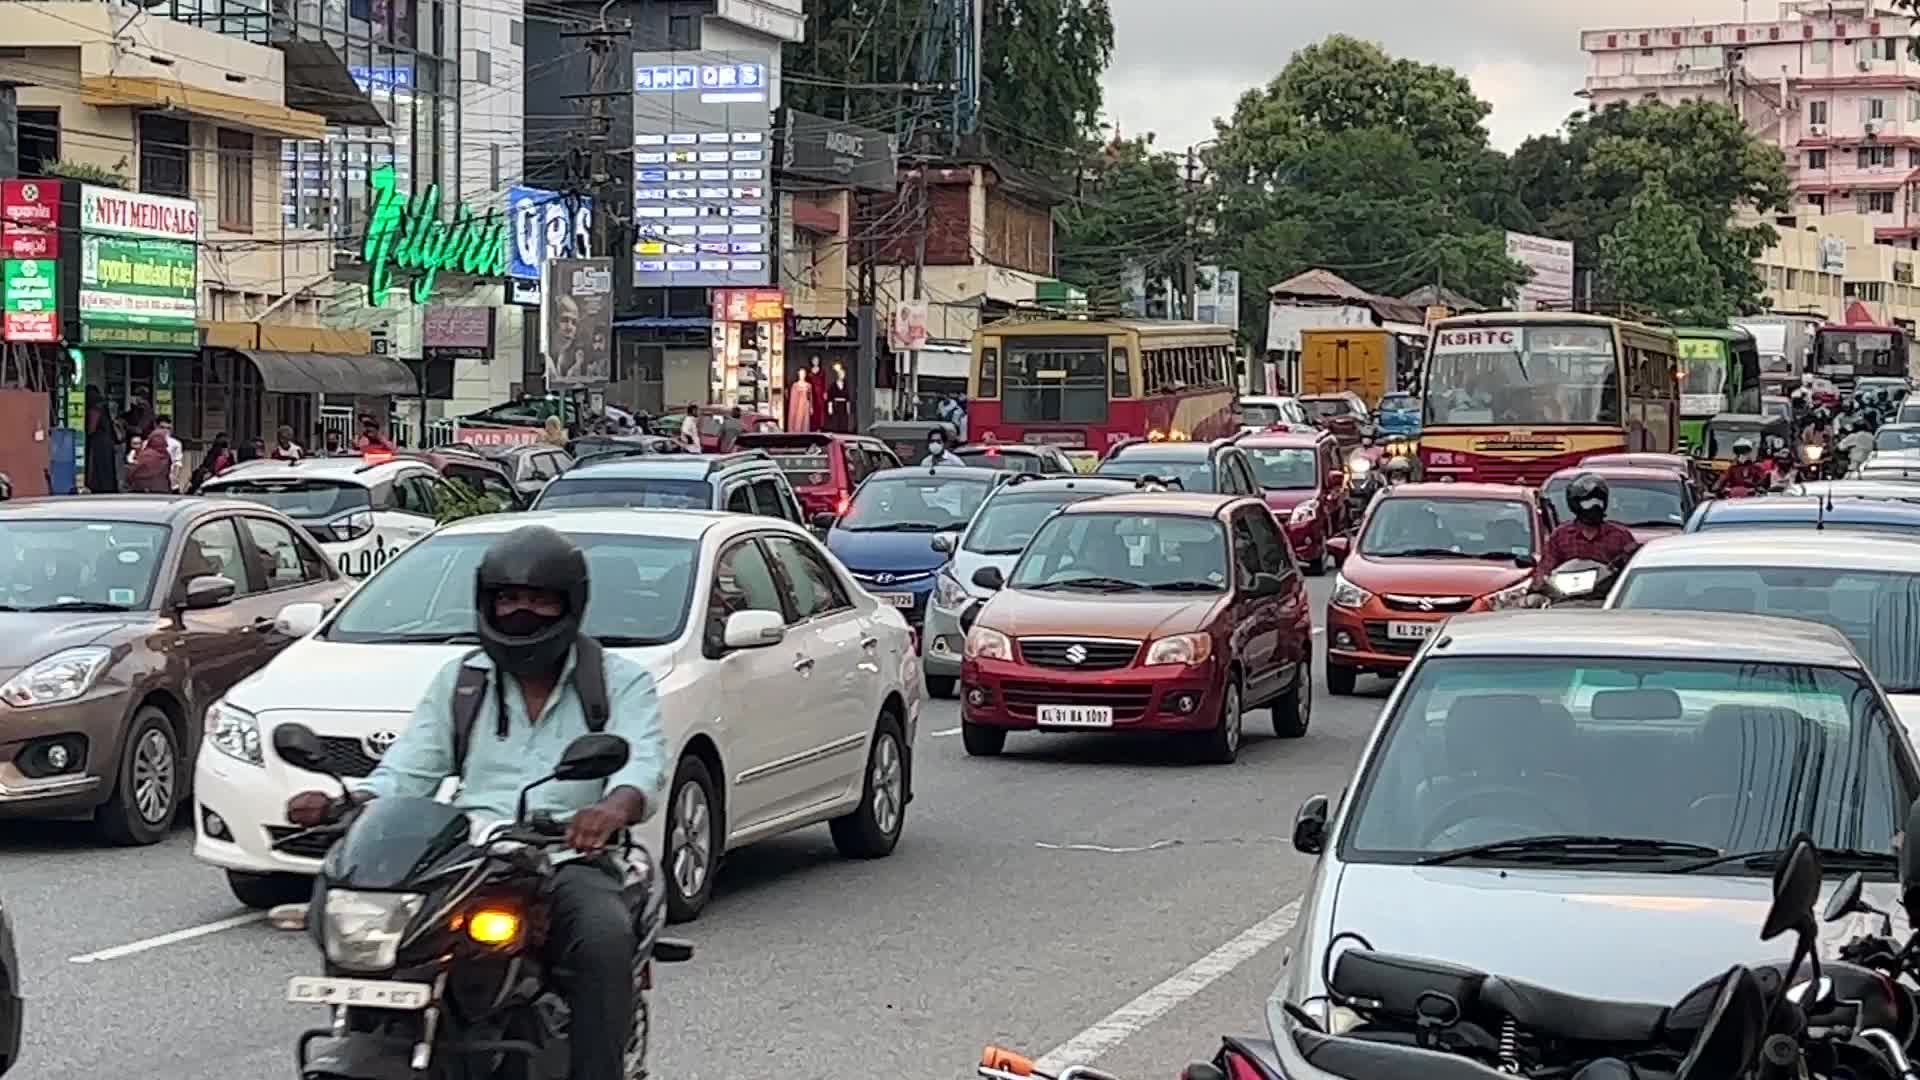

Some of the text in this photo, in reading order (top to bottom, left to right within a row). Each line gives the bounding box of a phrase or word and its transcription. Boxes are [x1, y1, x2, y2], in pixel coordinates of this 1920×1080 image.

[95, 197, 196, 233] NIVI MEDICALS
[1441, 331, 1514, 346] KSRTC
